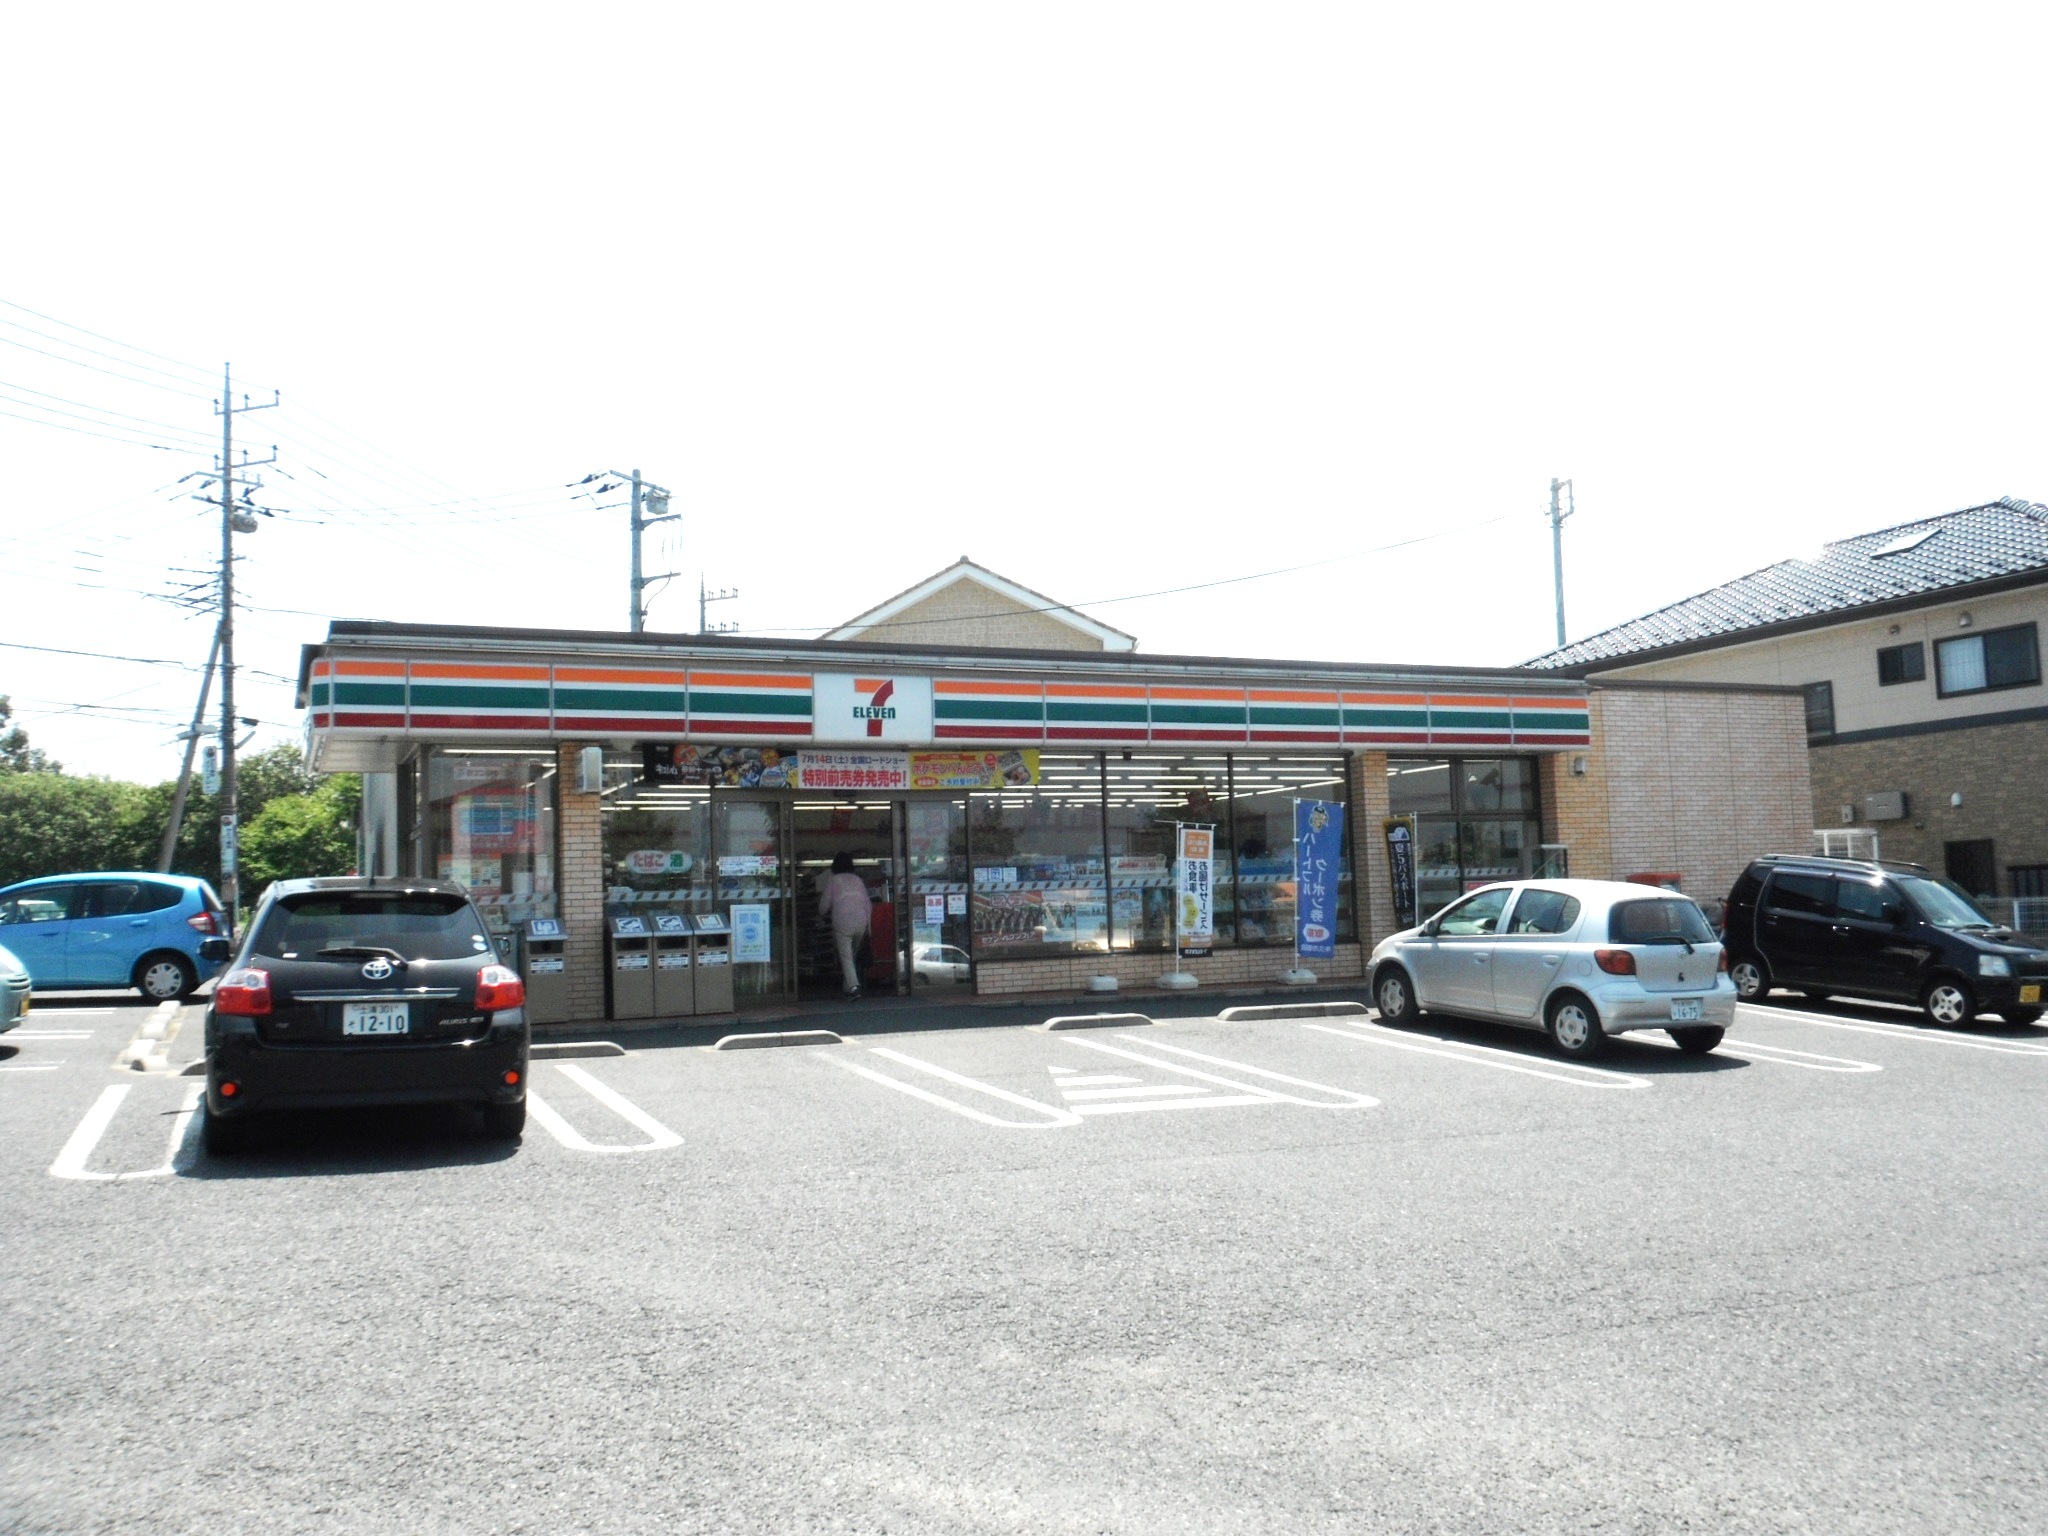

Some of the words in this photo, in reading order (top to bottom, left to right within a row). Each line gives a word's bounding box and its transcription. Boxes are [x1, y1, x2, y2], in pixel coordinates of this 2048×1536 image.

[854, 678, 894, 737] 7
[633, 853, 665, 868] たばこ
[669, 853, 684, 868] 酒
[360, 1015, 405, 1032] 12-10
